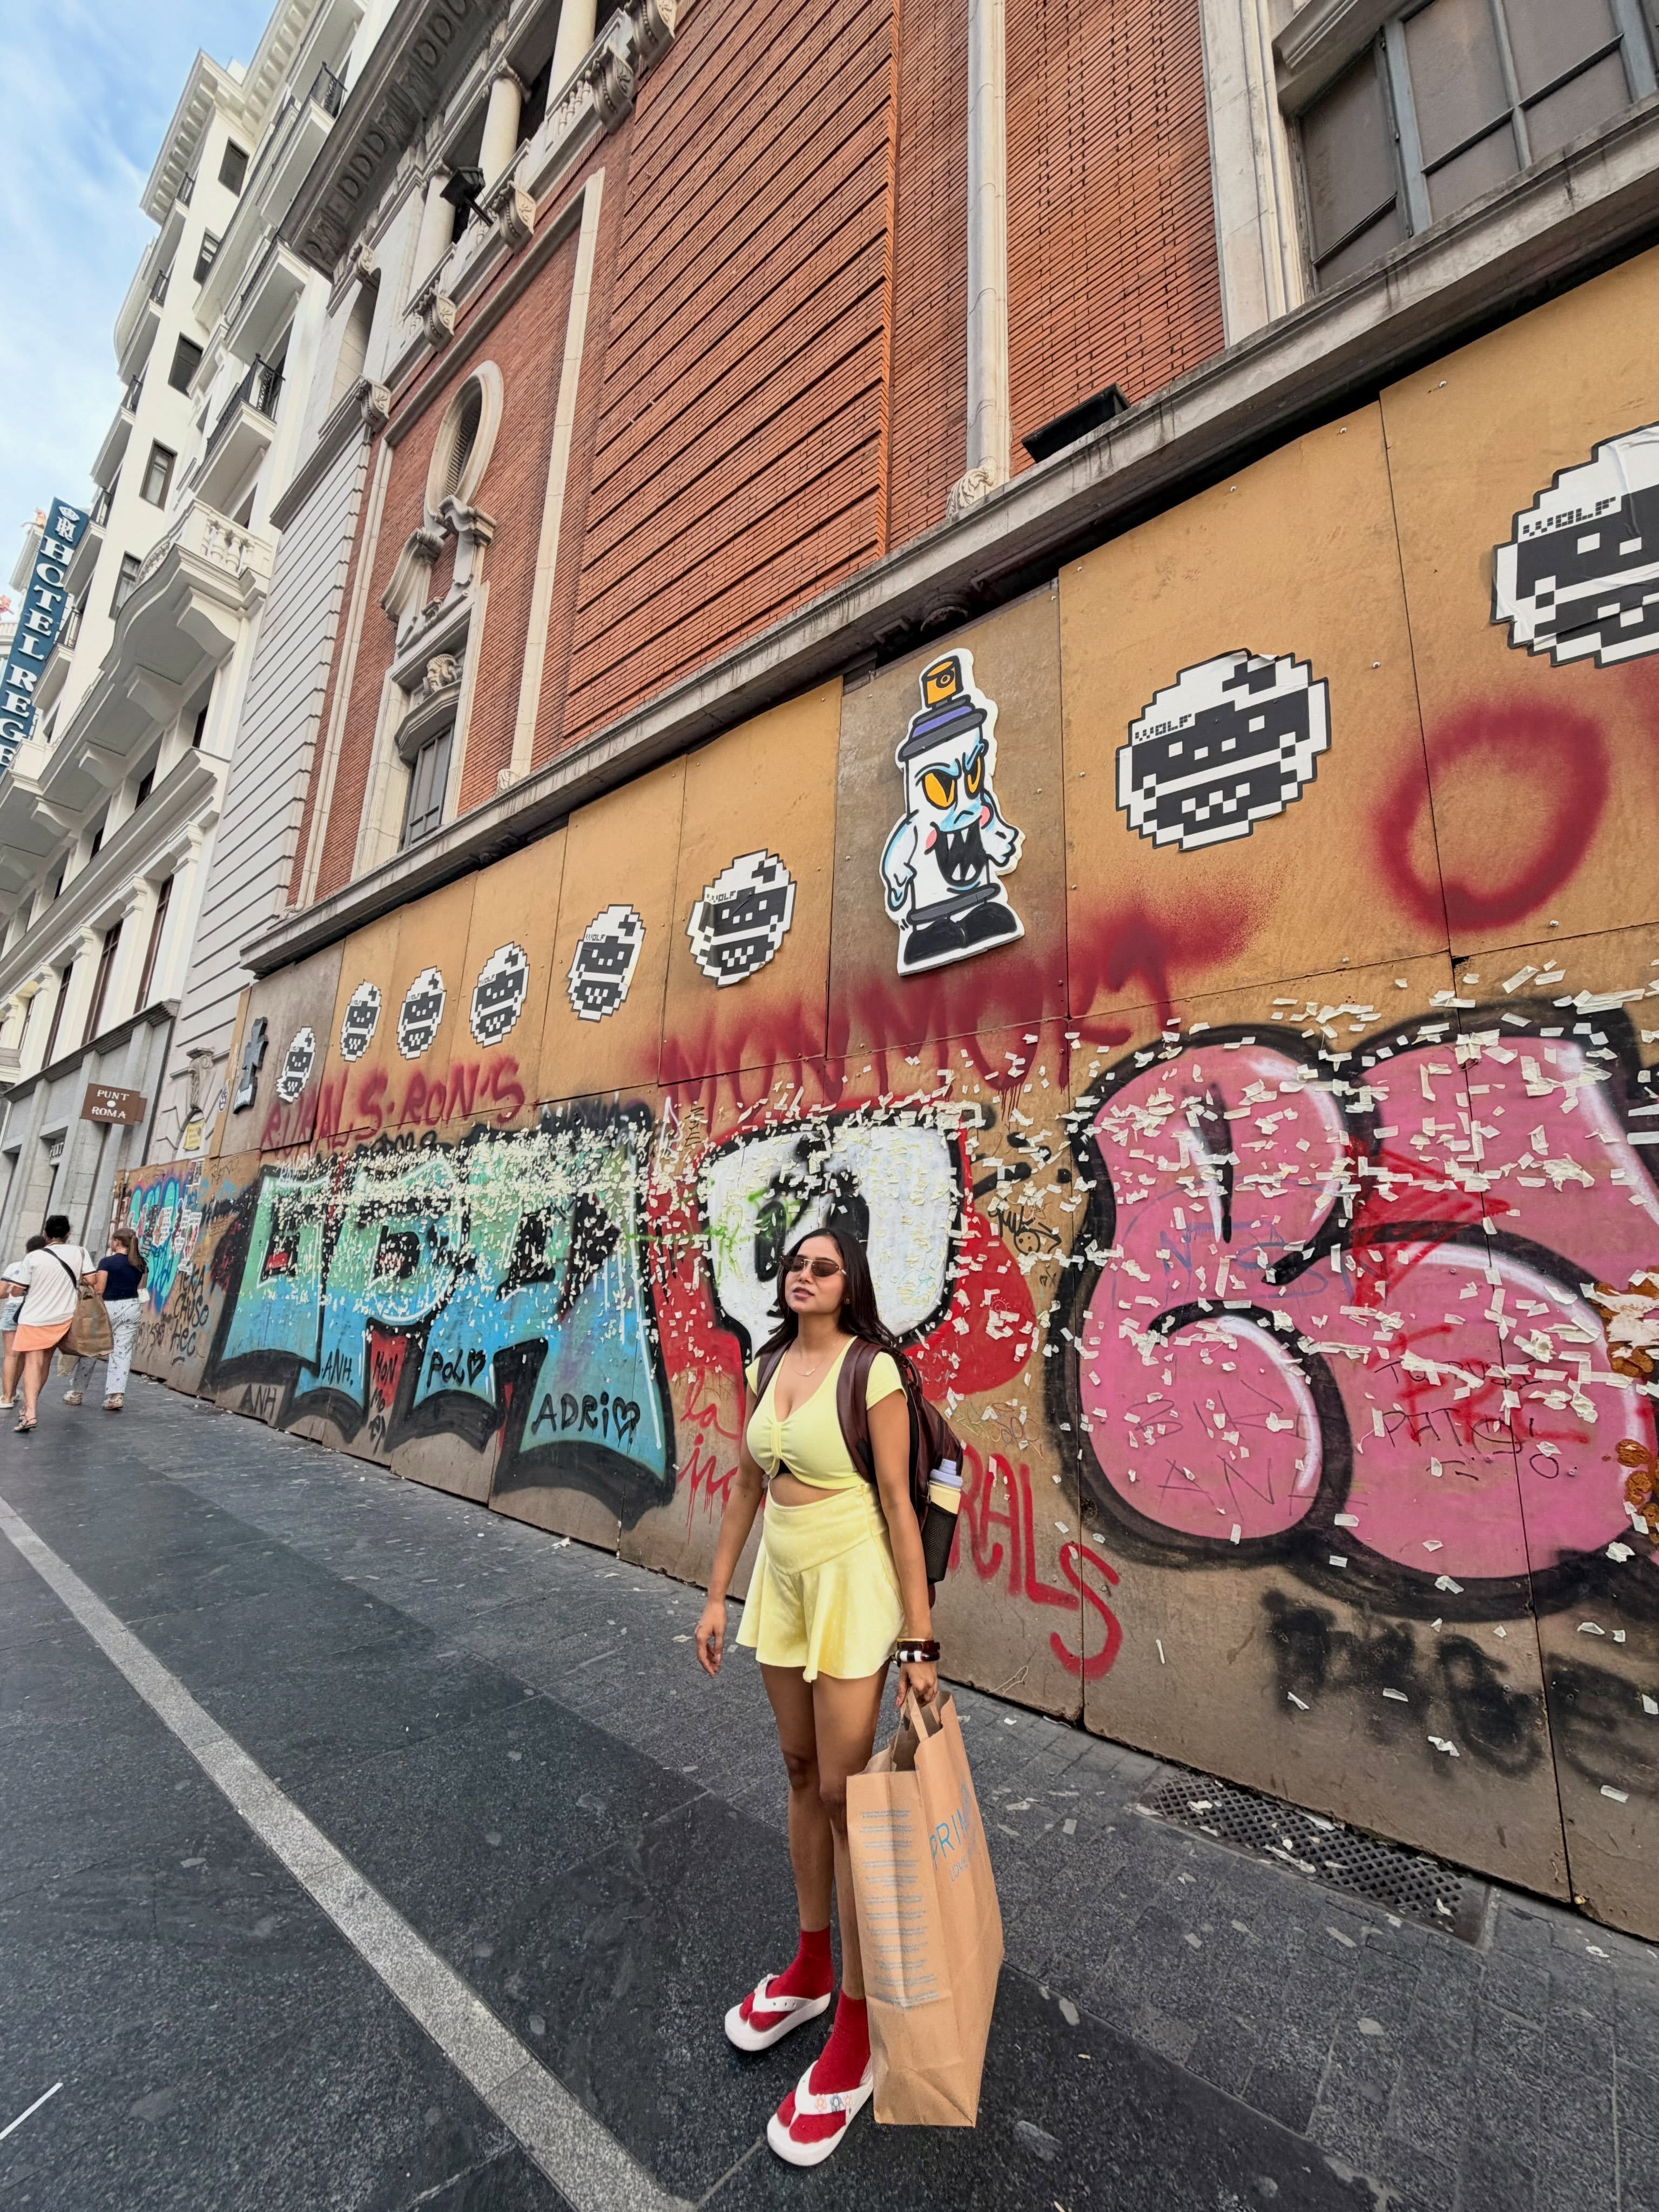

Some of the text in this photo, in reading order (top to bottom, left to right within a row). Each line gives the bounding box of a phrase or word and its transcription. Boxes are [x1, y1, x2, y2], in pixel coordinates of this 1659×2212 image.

[1523, 496, 1616, 537] WOLF
[18, 535, 74, 660] HOTEL
[1135, 713, 1192, 741] WOLF
[706, 890, 736, 903] WOLF
[585, 934, 606, 942] WOLF
[97, 1089, 130, 1101] PUNT
[91, 1105, 126, 1119] ROMA
